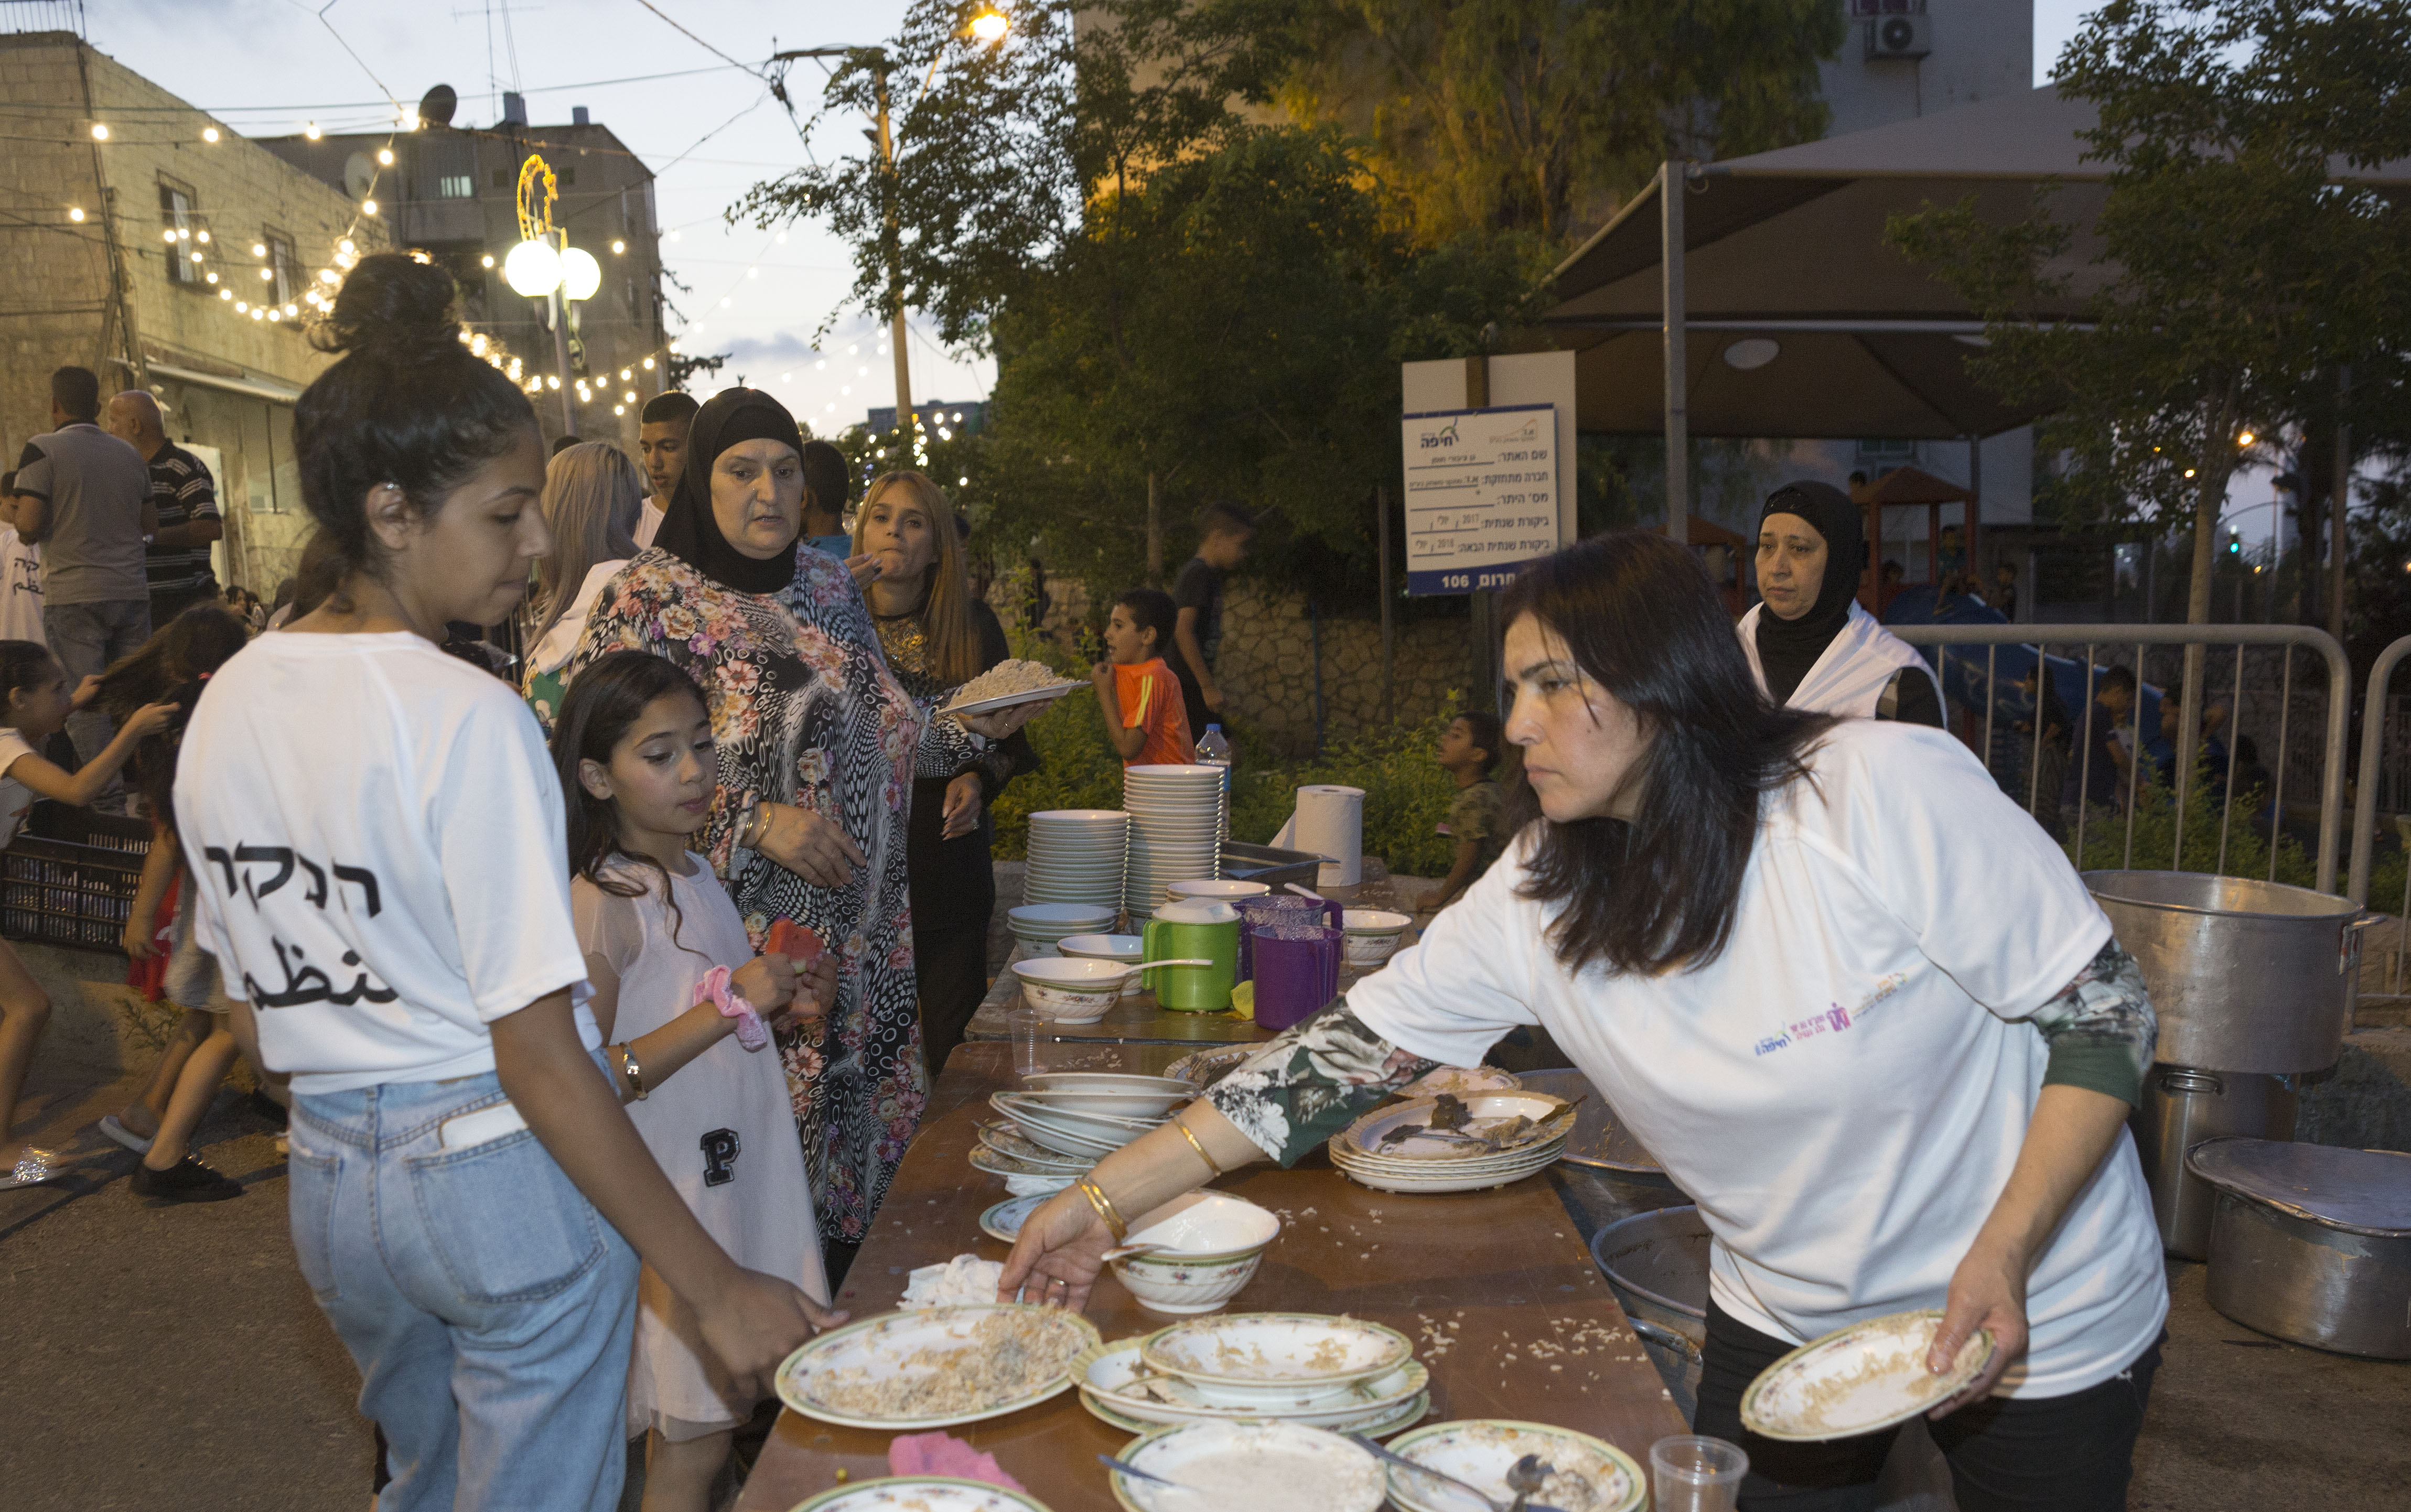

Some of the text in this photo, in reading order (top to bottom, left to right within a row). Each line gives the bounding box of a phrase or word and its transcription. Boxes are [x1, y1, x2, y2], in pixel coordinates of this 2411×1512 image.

[1420, 435, 1453, 448] חיפה
[1498, 451, 1528, 462] האתר:
[1531, 449, 1547, 461] שם
[1524, 471, 1548, 482] חברה
[1497, 494, 1525, 505] היתר:
[1517, 516, 1549, 528] ביקורת
[1487, 541, 1516, 552] שנתית
[1519, 539, 1550, 552] ביקורת
[1442, 575, 1469, 588] 106
[700, 1127, 741, 1187] P
